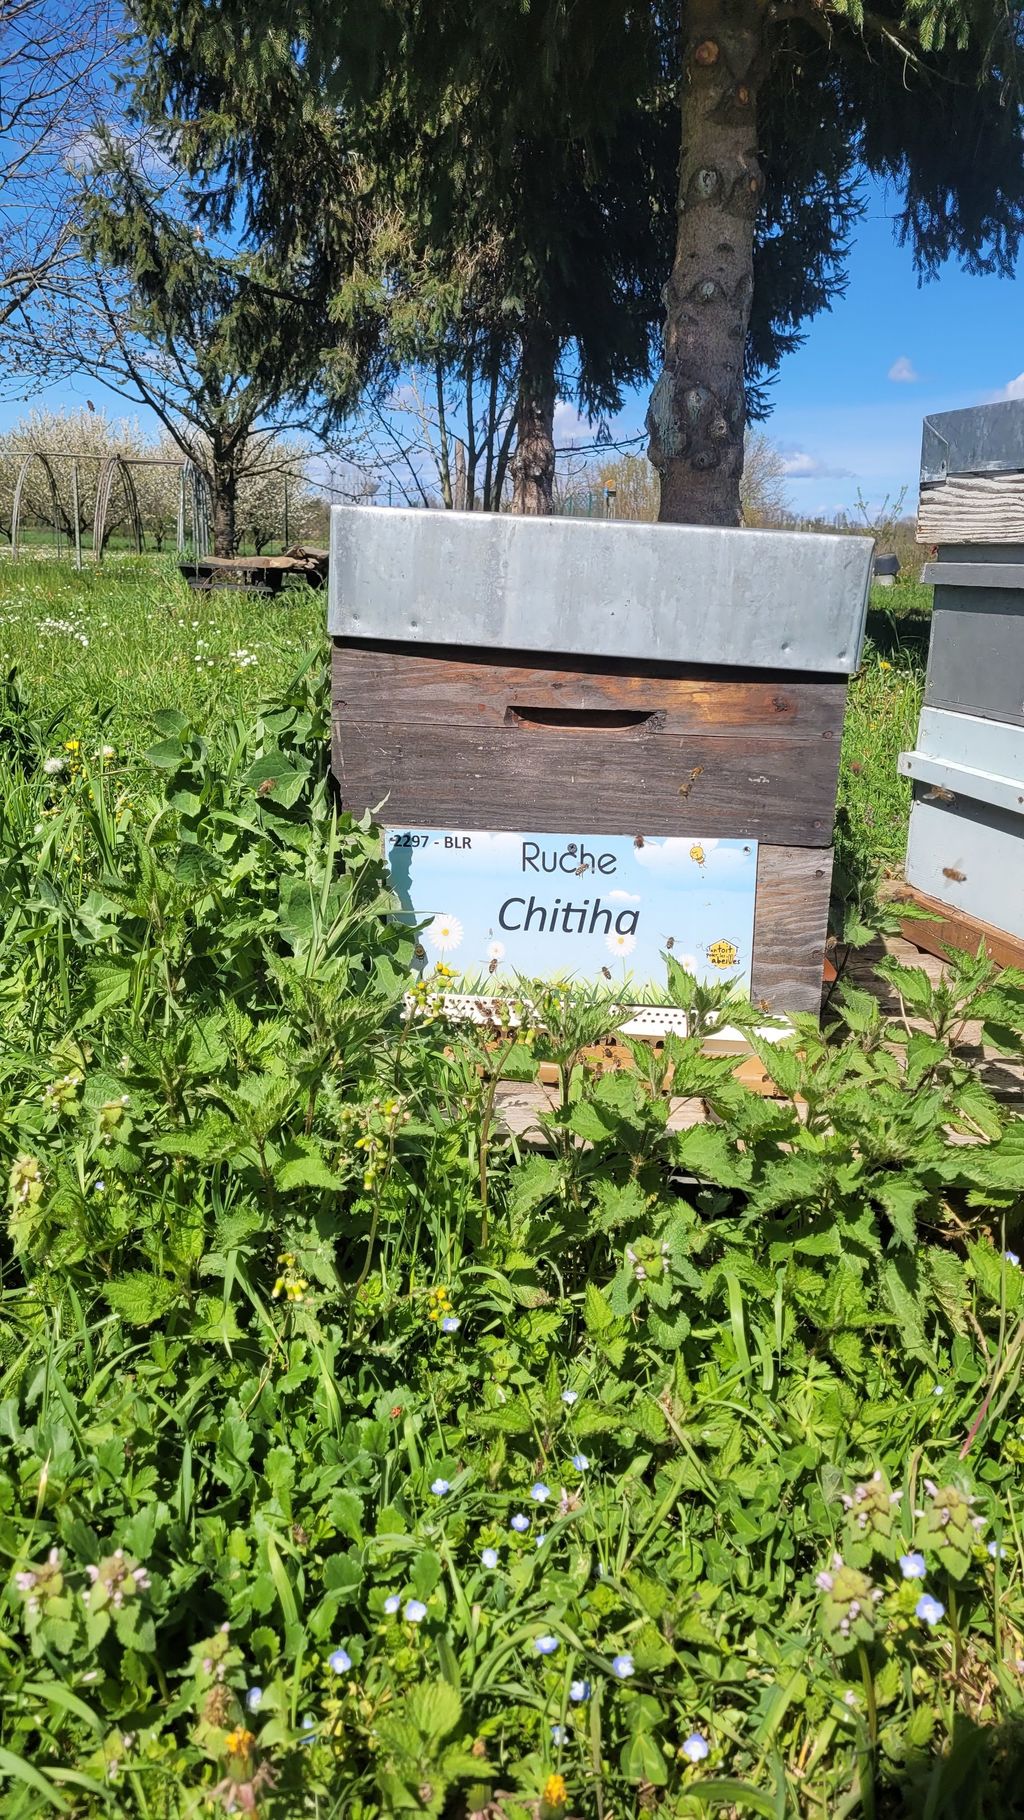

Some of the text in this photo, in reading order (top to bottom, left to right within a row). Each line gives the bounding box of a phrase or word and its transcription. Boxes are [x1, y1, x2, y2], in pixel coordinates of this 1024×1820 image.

[394, 834, 429, 848] 2297
[444, 836, 472, 849] BLR
[522, 842, 617, 874] Ruche
[498, 895, 641, 936] Chitiha
